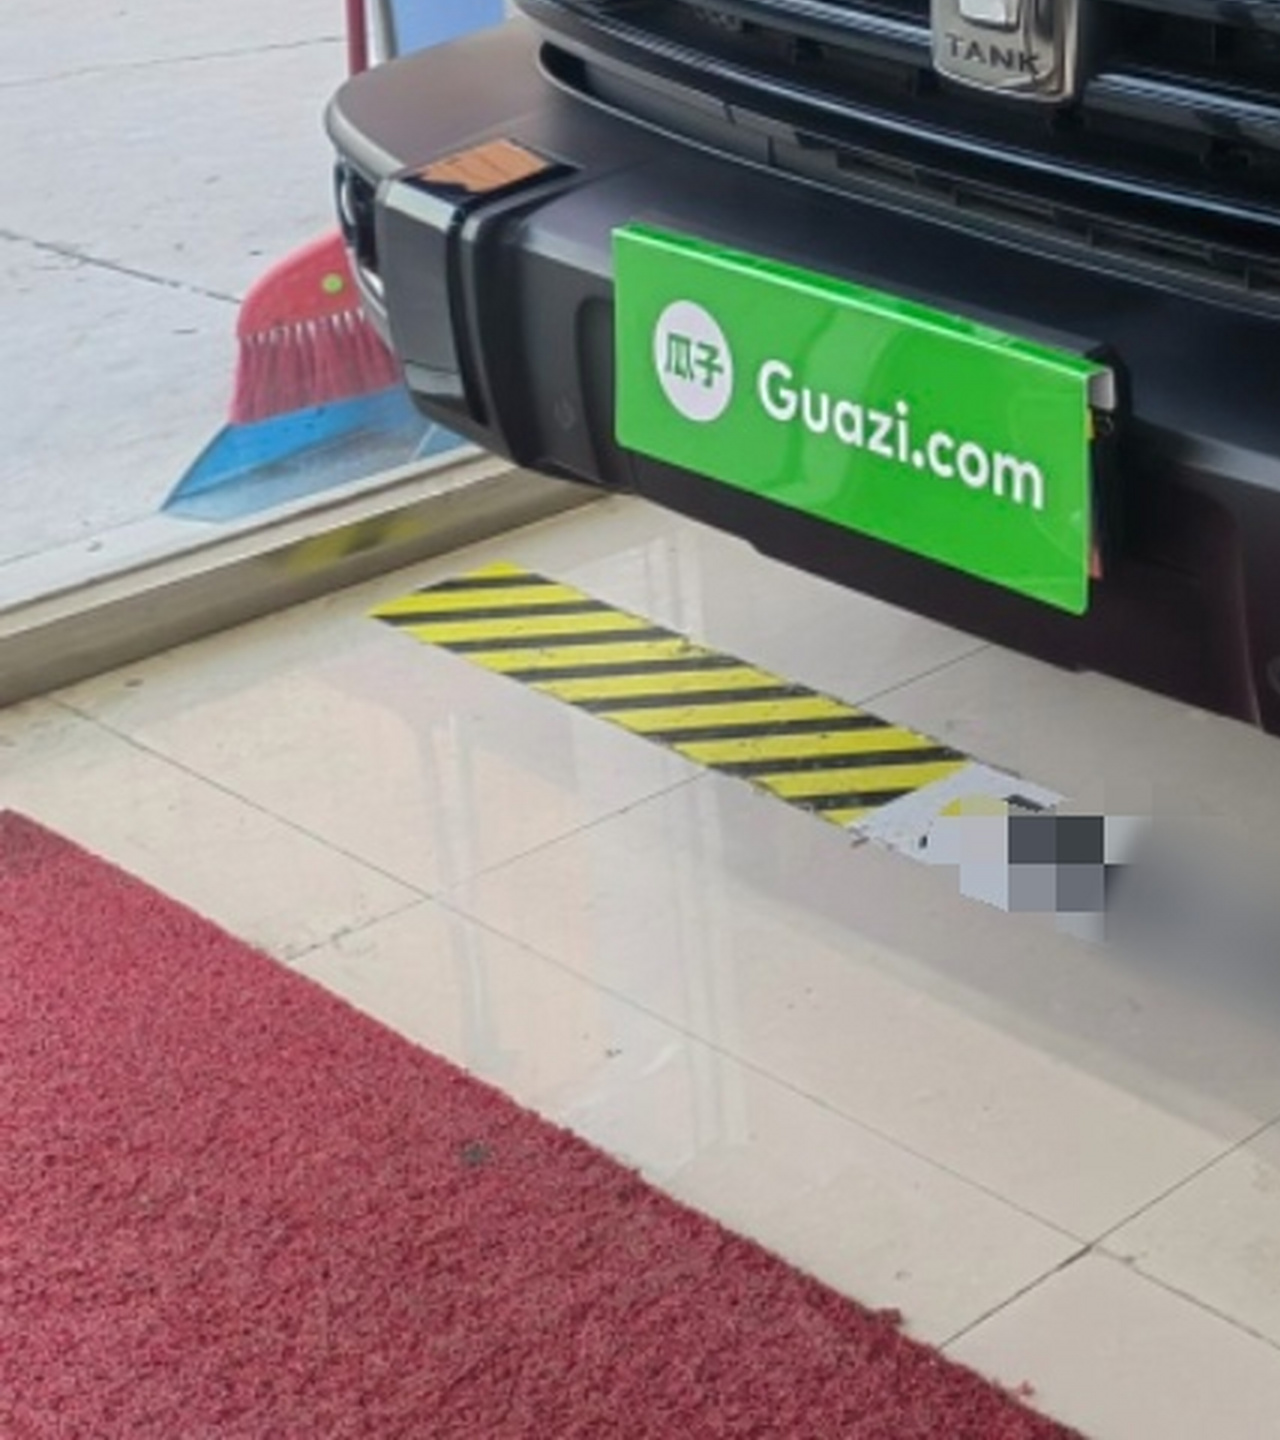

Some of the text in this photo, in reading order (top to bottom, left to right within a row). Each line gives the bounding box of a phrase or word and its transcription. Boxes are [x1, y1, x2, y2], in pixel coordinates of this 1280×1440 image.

[945, 32, 1039, 76] TANK
[664, 332, 724, 388] 瓜子
[757, 359, 1043, 511] Guazi.com
